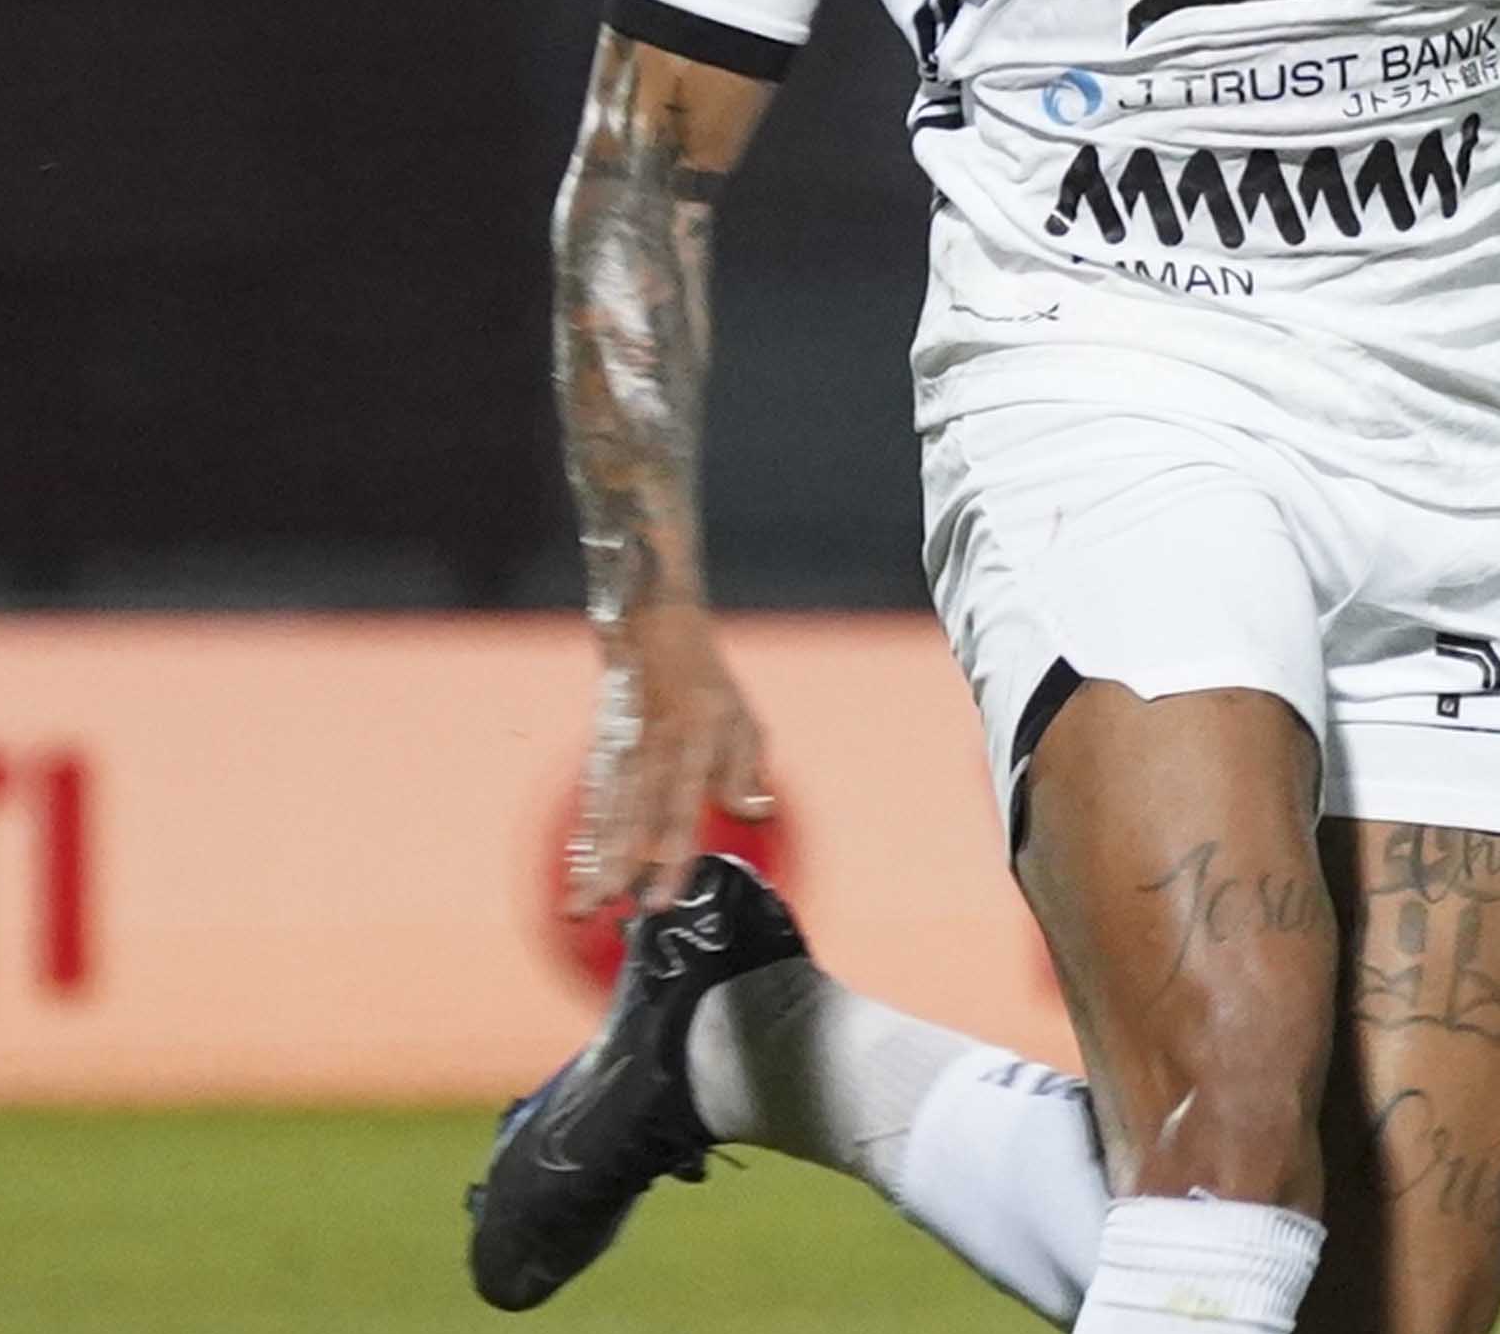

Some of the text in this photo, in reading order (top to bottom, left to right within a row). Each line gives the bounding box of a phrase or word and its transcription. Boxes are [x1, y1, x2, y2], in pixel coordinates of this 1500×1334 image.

[1118, 16, 1499, 111] J TRUST BANK
